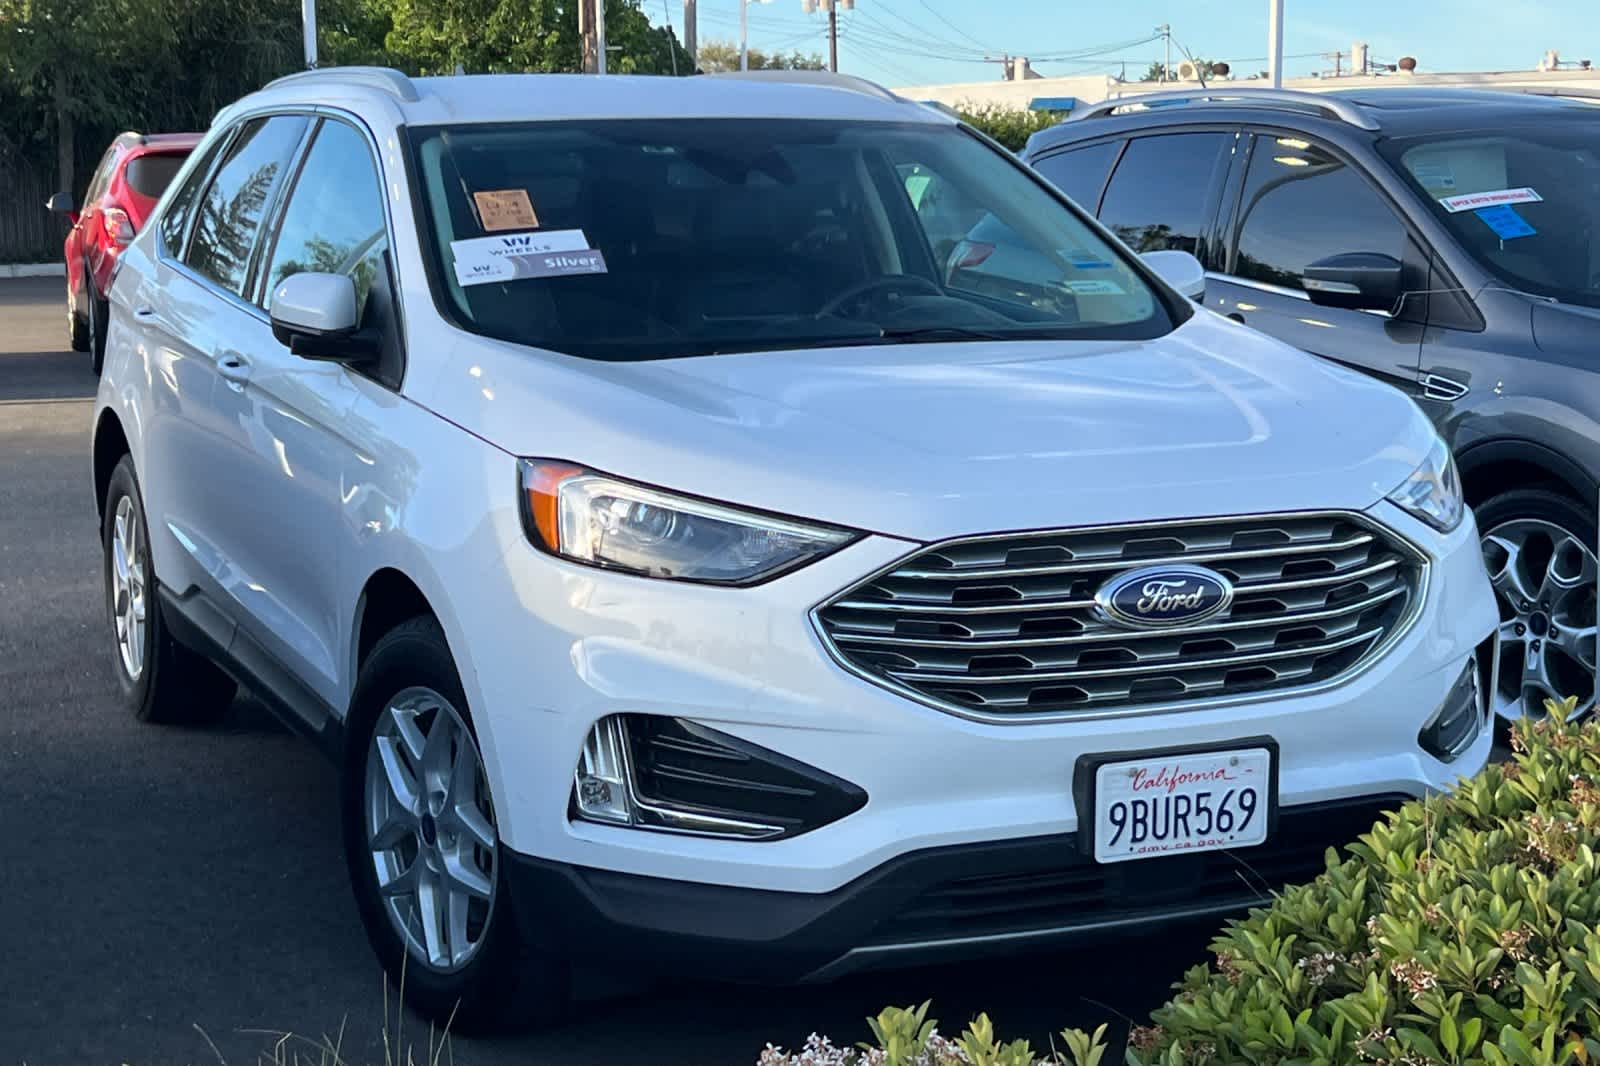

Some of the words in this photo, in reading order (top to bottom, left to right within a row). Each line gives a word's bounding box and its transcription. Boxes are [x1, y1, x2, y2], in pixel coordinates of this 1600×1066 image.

[489, 245, 551, 255] WHEELS
[543, 255, 598, 269] Silver
[1137, 580, 1204, 613] Ford
[1133, 765, 1236, 793] California
[1109, 787, 1257, 847] 9BUR569
